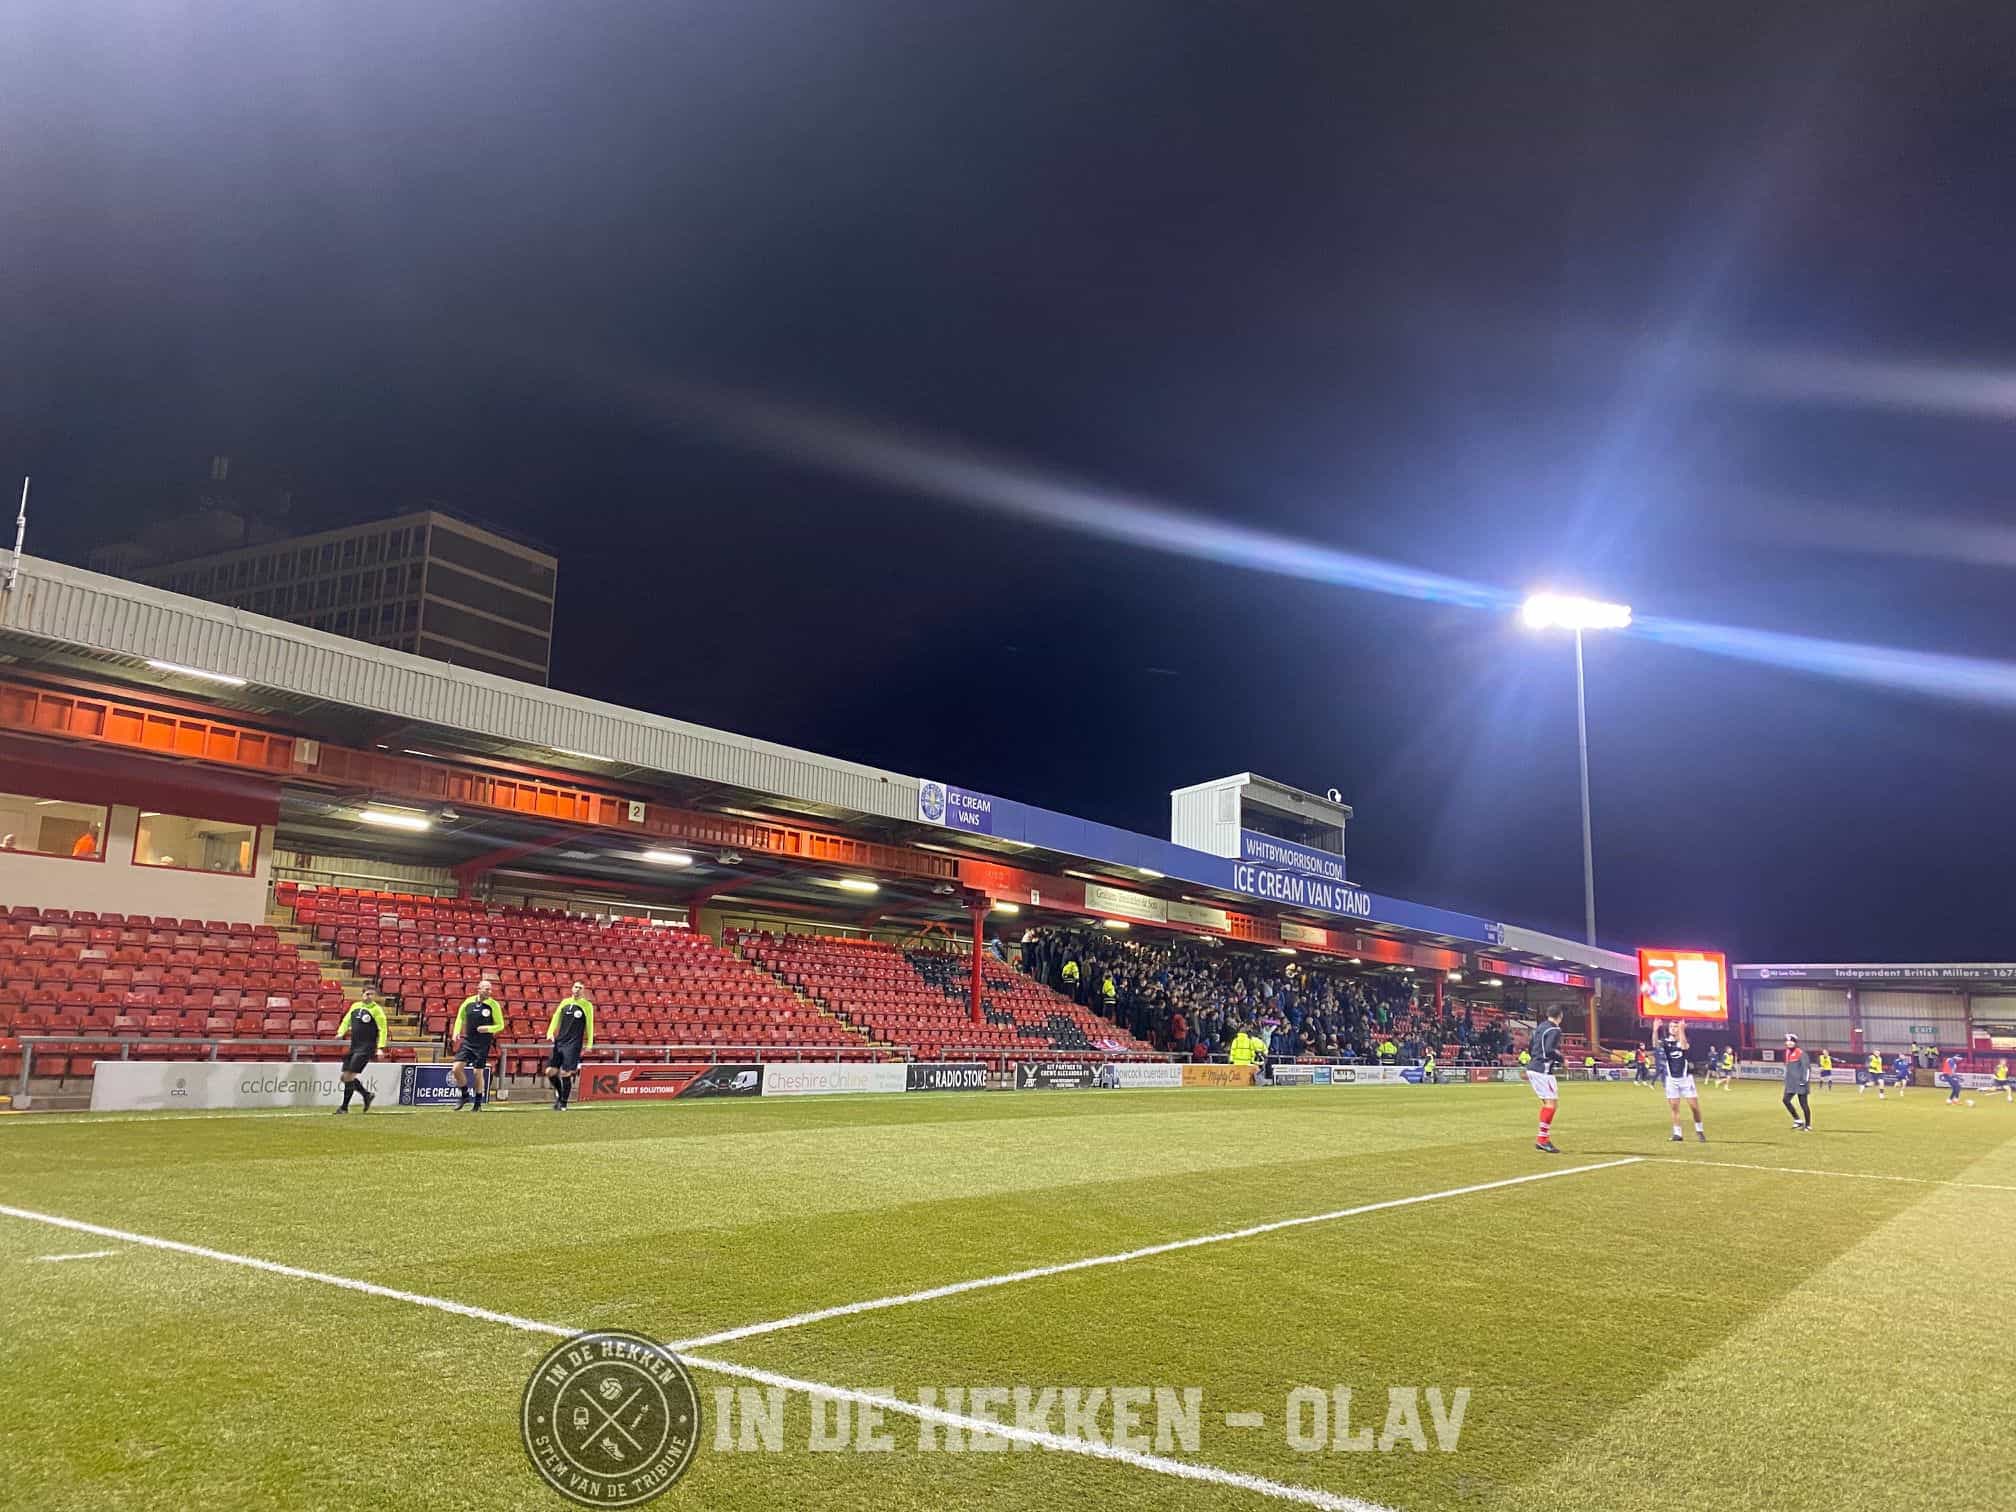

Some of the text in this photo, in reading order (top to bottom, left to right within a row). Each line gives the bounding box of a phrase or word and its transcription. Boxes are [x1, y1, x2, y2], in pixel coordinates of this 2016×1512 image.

[948, 791, 991, 813] ICE CREAM
[633, 806, 641, 817] 2
[958, 810, 980, 826] VANS
[1246, 838, 1343, 880] WHITBYMORRISON.COM
[1234, 864, 1371, 916] ICE CREAM VAN STAND
[1834, 968, 1900, 978] Independent
[1904, 968, 1939, 977] British
[1942, 968, 1980, 977] Millers
[767, 1072, 827, 1089] Cheshire
[829, 1071, 869, 1088] Online
[935, 1069, 962, 1088] RADIO
[963, 1069, 987, 1087] STOKE
[416, 1087, 431, 1098] ICE
[620, 1086, 675, 1095] FLEET SOLUTIONS
